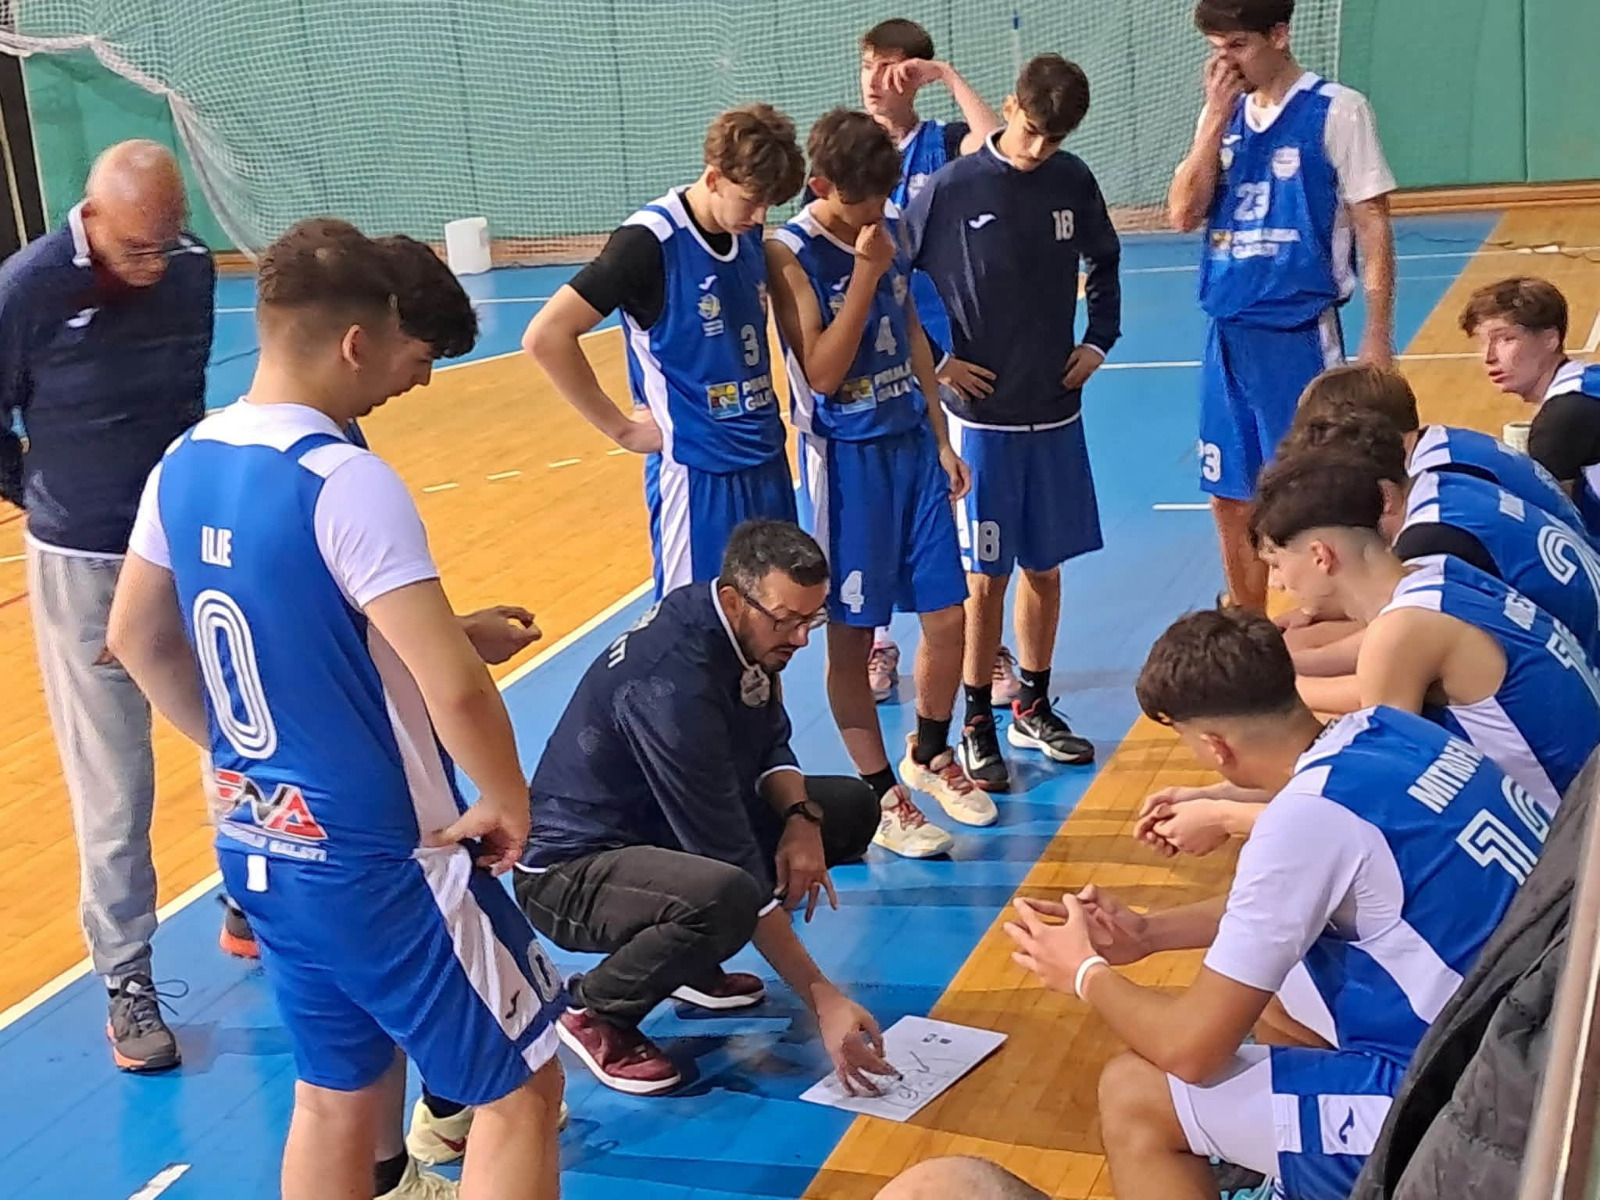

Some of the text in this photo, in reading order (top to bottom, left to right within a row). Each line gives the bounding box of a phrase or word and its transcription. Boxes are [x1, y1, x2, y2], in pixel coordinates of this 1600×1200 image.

[1234, 181, 1270, 220] 23
[1052, 209, 1075, 240] 18
[741, 324, 760, 366] 3
[875, 316, 897, 355] 4
[840, 570, 865, 613] 4
[193, 588, 278, 760] 0
